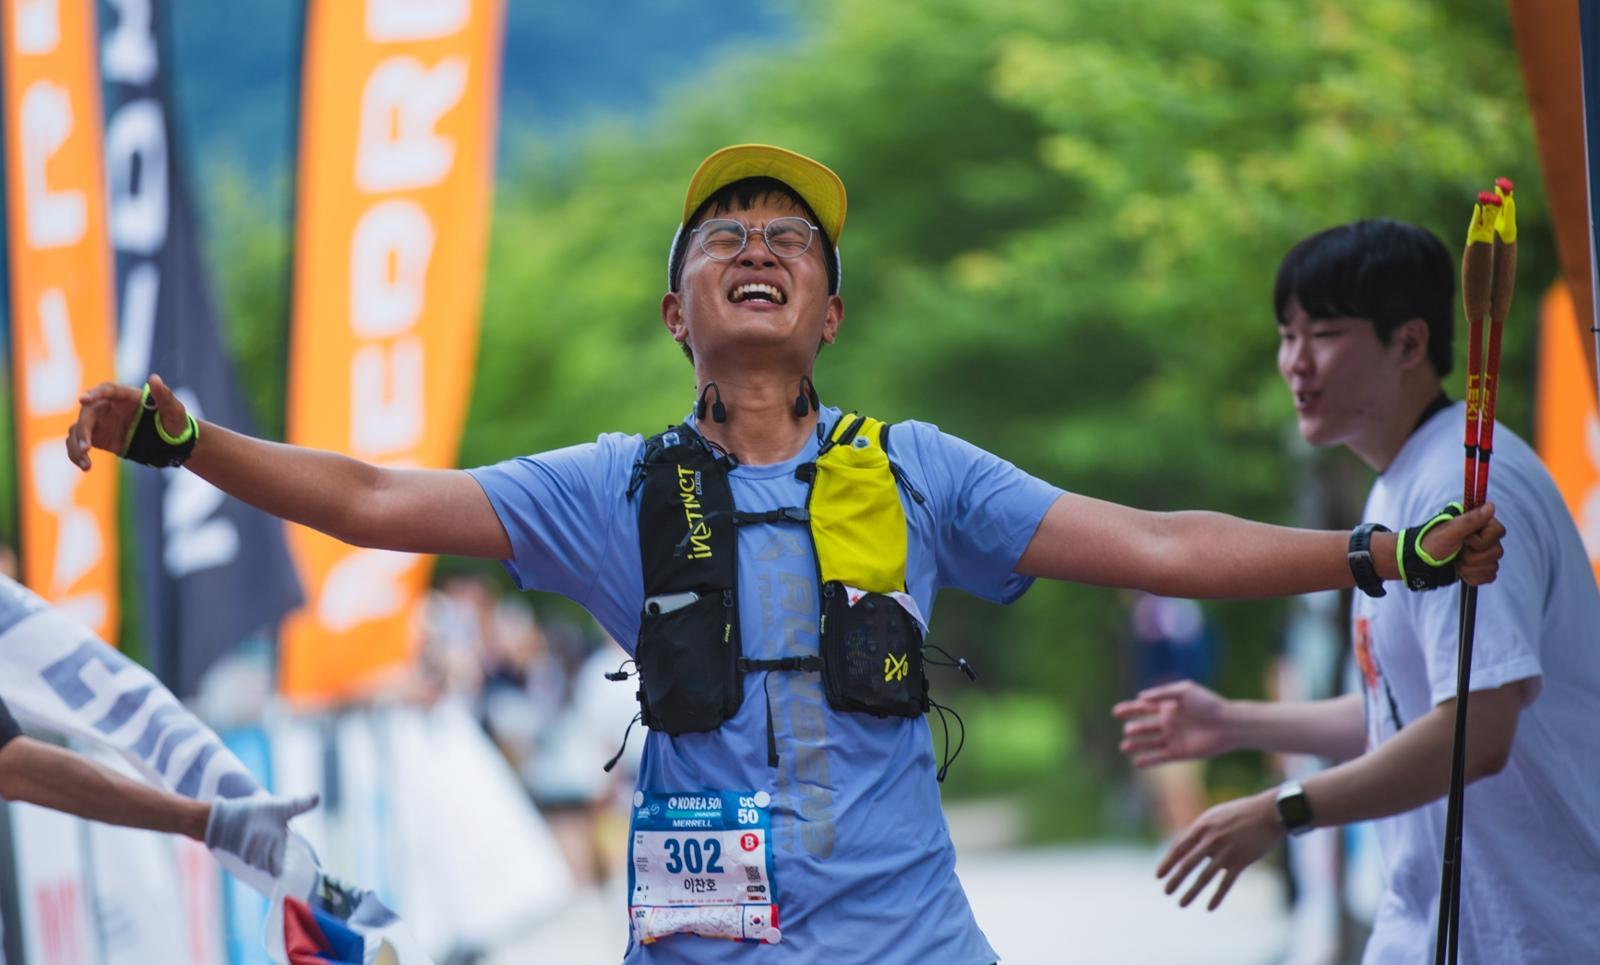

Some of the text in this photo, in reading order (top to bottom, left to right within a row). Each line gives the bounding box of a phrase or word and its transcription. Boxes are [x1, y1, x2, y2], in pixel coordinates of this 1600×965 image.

[1467, 375, 1480, 420] LEKI
[672, 819, 713, 828] MERRELL
[737, 808, 759, 824] 50
[663, 838, 725, 875] 302
[683, 878, 718, 893] 이찬호
